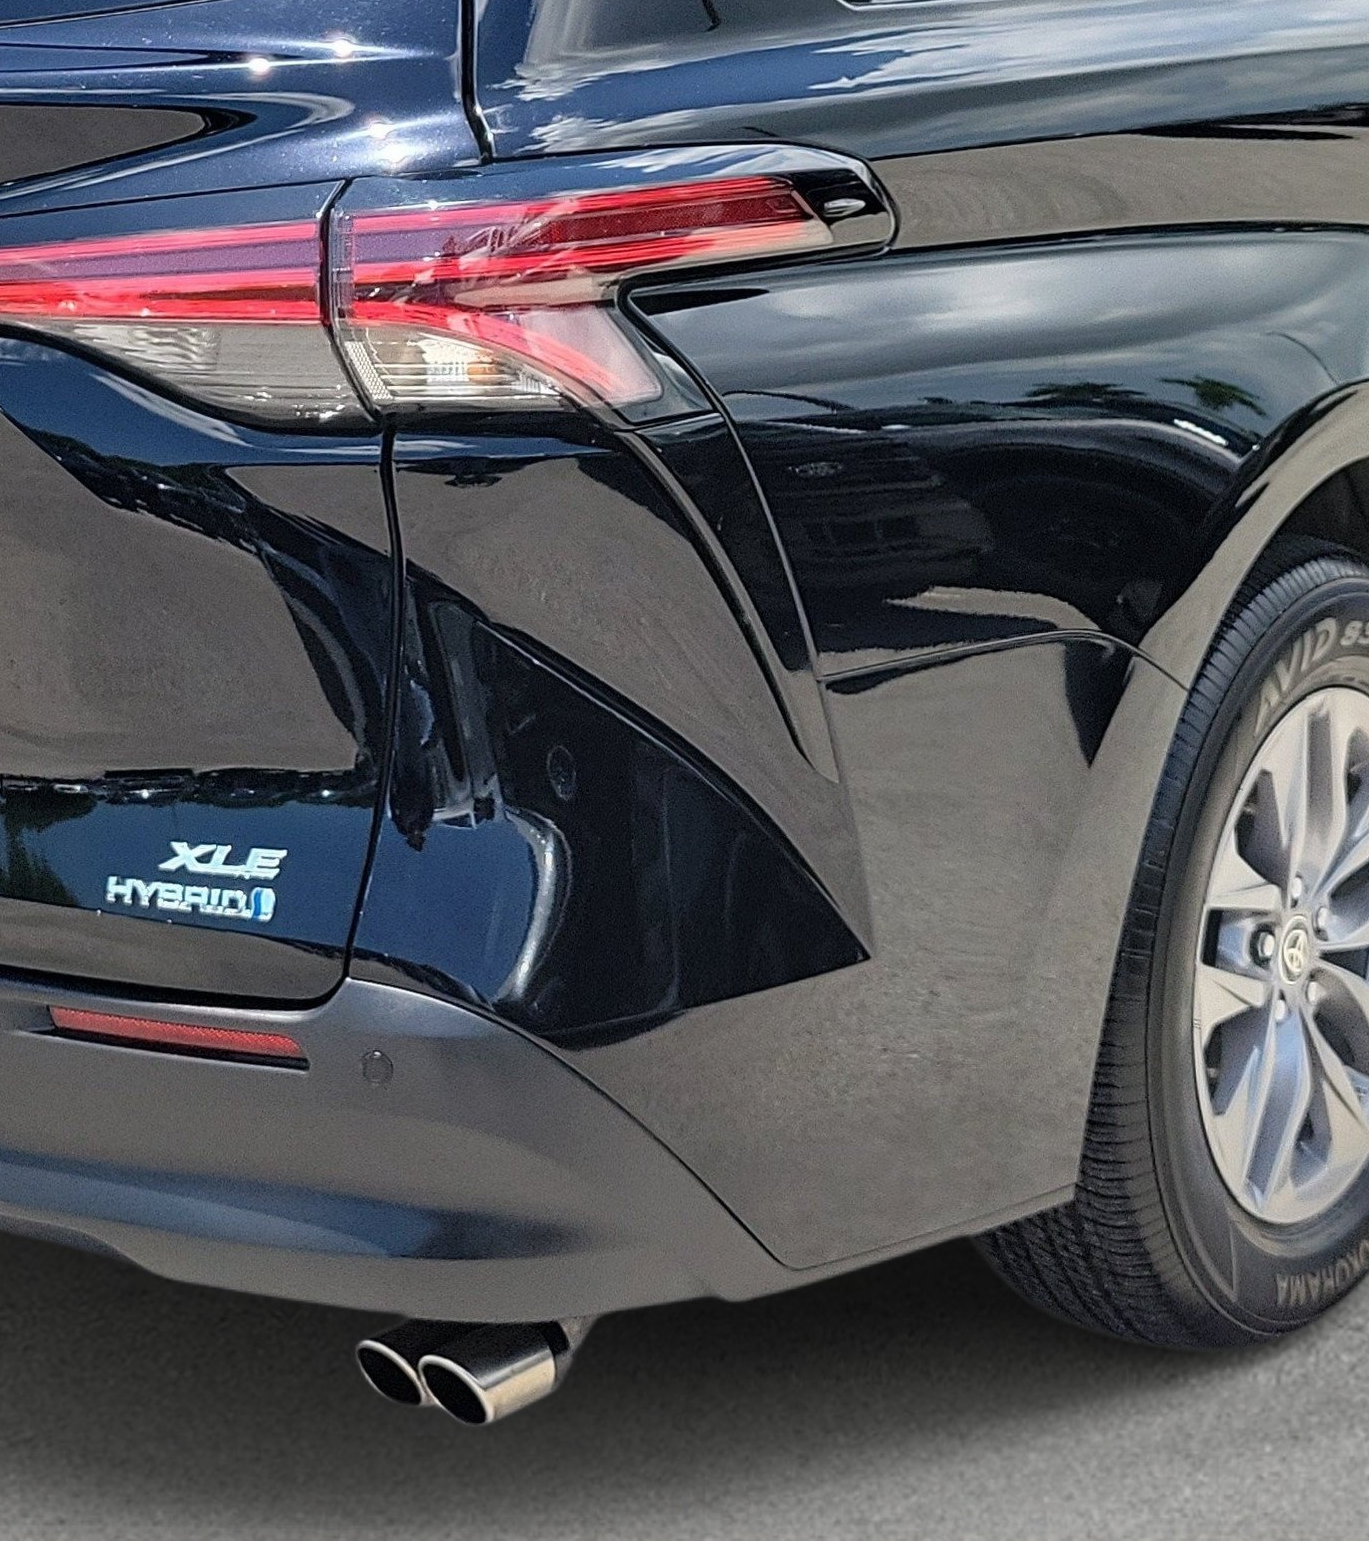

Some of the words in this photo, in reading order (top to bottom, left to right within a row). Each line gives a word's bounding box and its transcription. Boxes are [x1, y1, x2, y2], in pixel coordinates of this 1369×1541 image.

[1254, 616, 1338, 737] AVID
[158, 841, 288, 880] XLE
[105, 875, 252, 919] HYBRID
